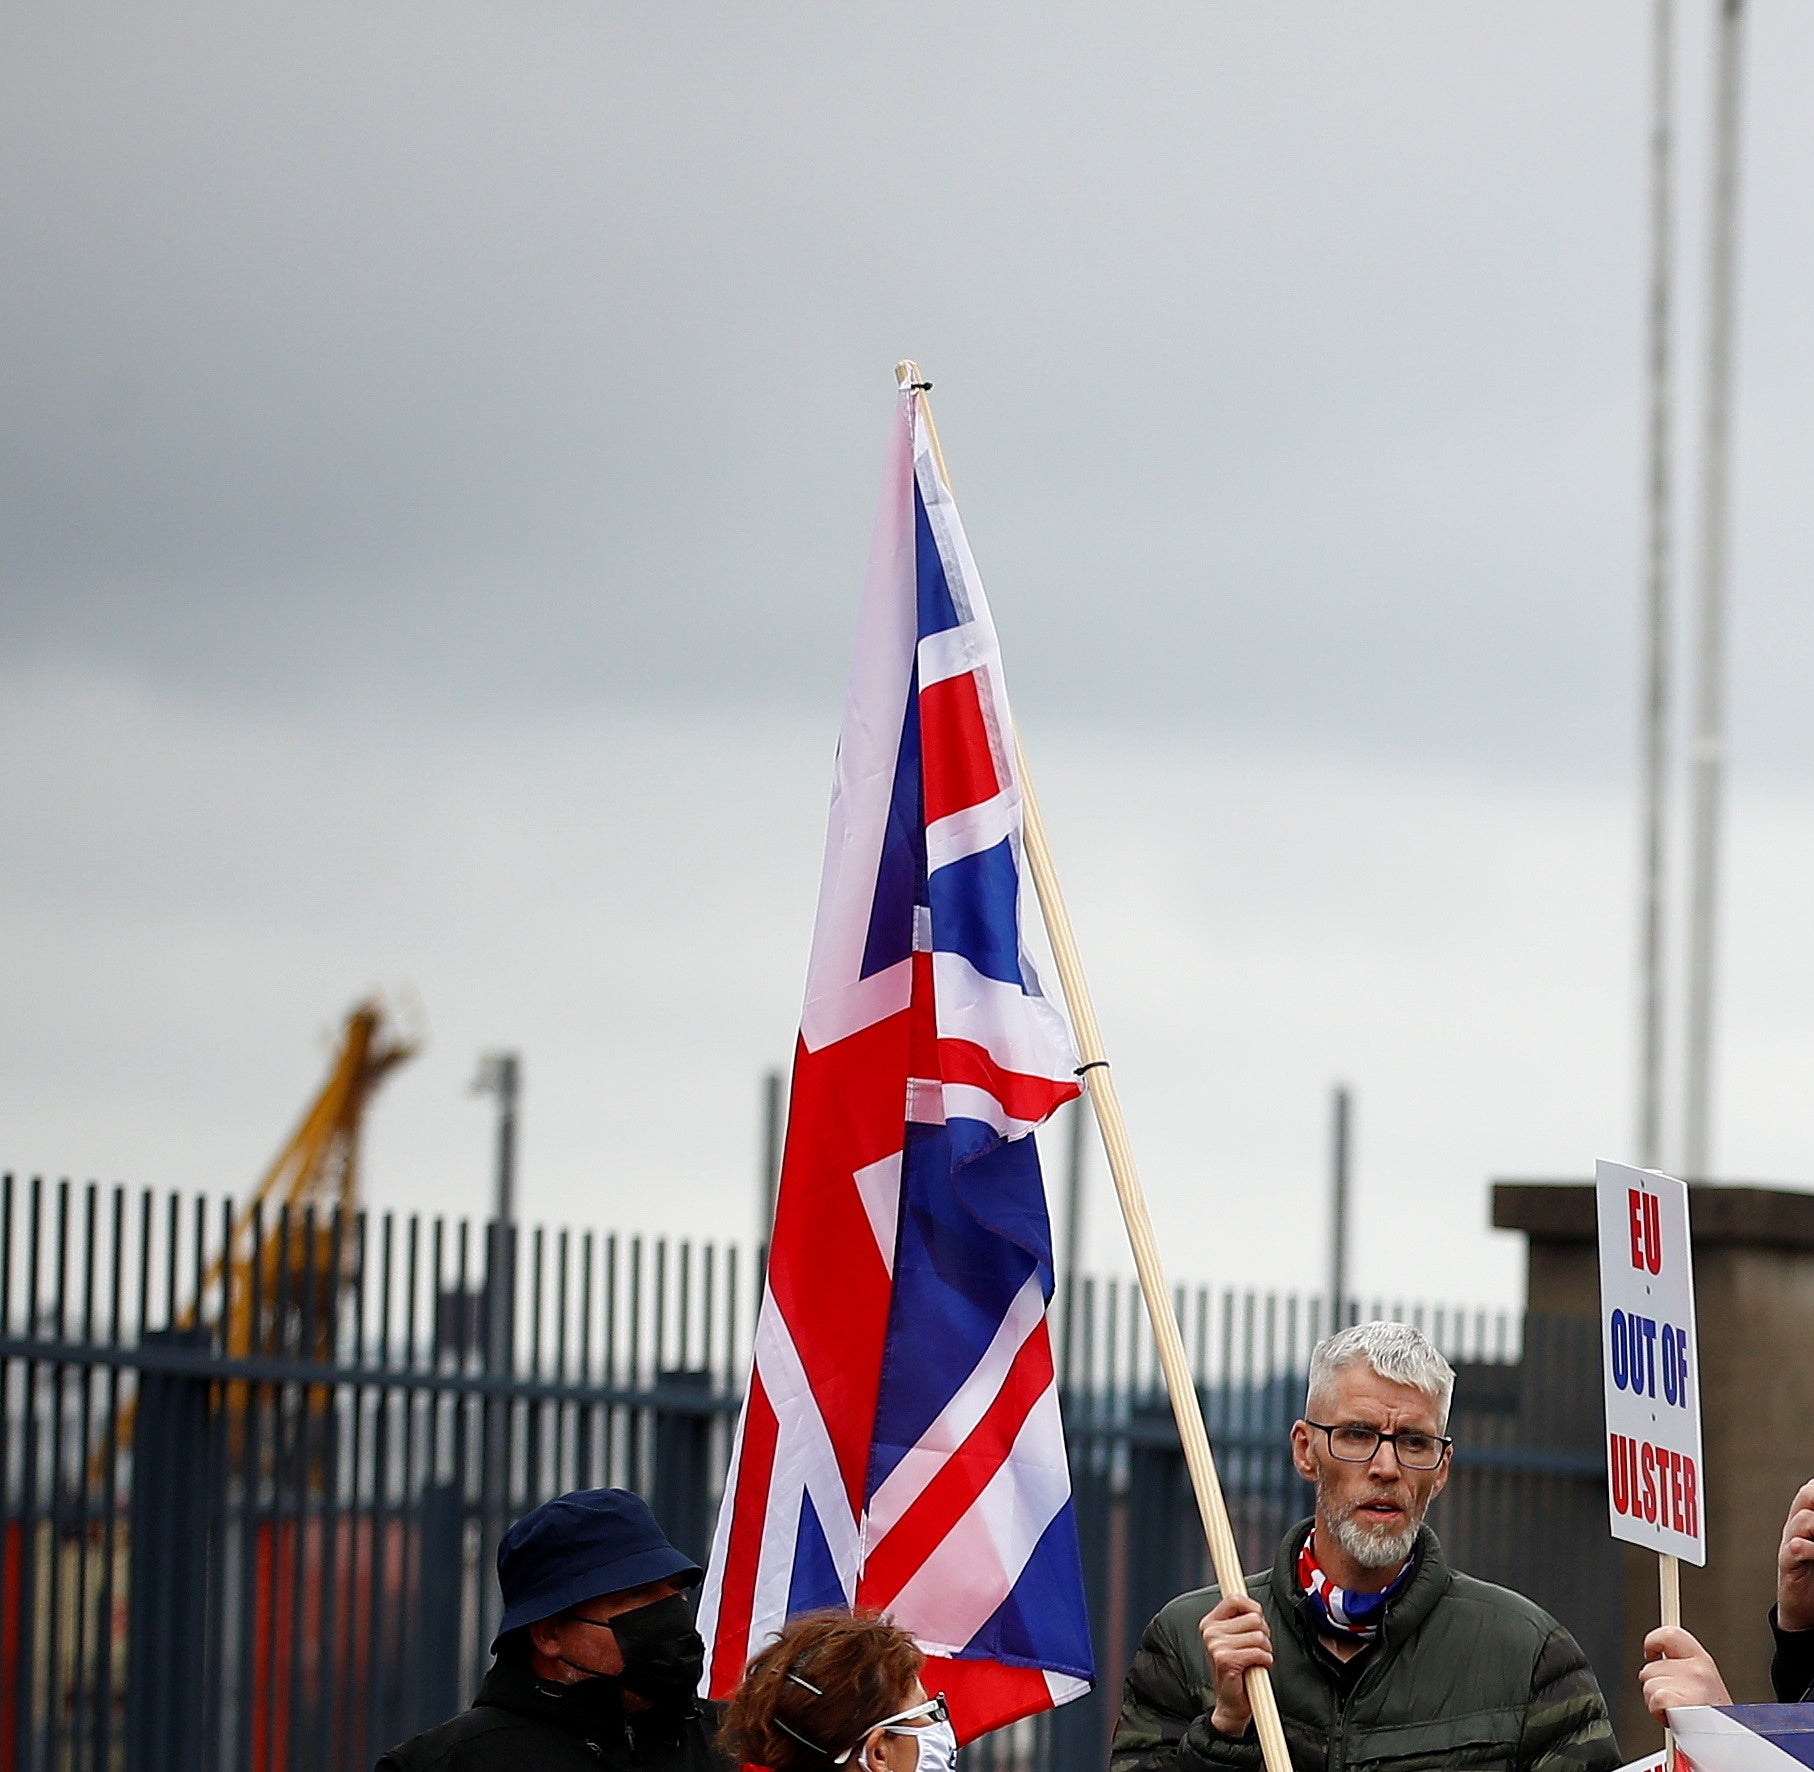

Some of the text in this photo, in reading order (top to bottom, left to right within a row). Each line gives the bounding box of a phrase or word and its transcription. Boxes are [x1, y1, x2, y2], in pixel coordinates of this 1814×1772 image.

[1628, 1187, 1661, 1276] EU
[1611, 1308, 1688, 1409] OUT OF
[1610, 1432, 1699, 1539] ULSTER
